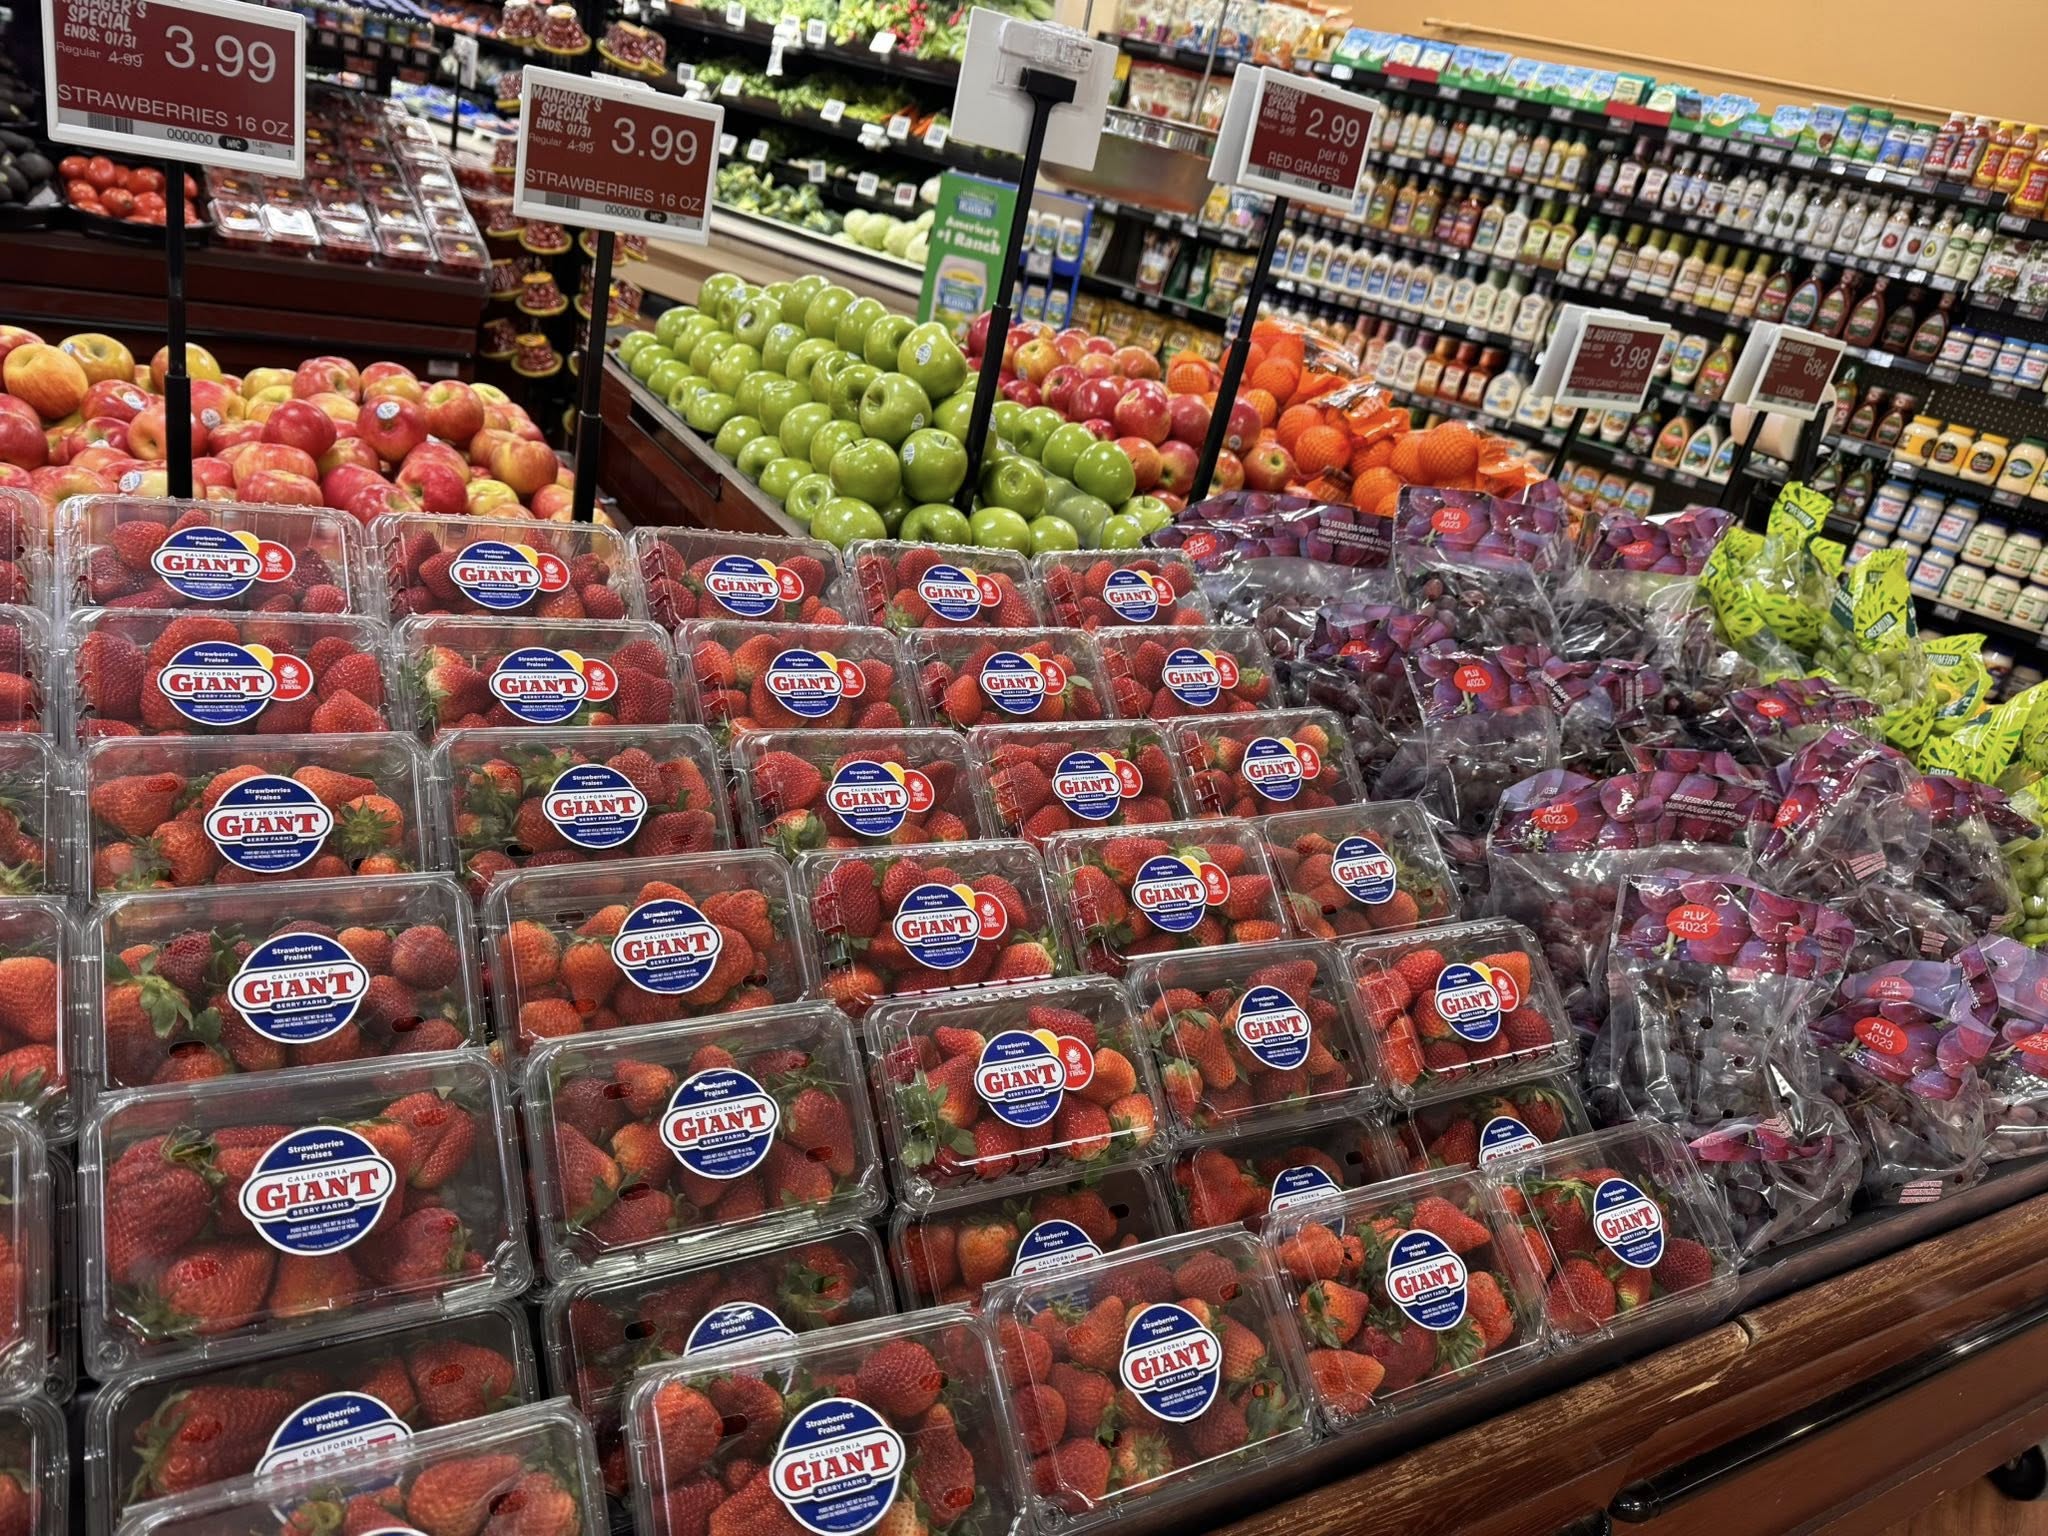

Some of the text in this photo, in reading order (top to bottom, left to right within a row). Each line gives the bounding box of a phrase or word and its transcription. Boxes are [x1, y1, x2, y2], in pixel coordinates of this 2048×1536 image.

[67, 4, 132, 33] SPECIAL
[64, 22, 137, 49] ENDS: 01/31
[56, 41, 145, 68] Regular 4.99
[164, 25, 277, 83] 3.99
[531, 84, 603, 112] MANAGER'S
[1267, 95, 1298, 114] SPECIAL
[57, 84, 294, 139] STRAWBERRIES 16 OZ.
[540, 102, 589, 125] SPECIAL
[167, 127, 213, 145] 000000
[536, 117, 592, 139] ENDS: 01/31
[1305, 108, 1361, 148] 2.99
[528, 133, 562, 147] Regular
[611, 117, 698, 166] 3.99
[1317, 148, 1349, 166] per lb
[1267, 151, 1341, 181] RED GRAPES
[525, 168, 654, 204] STRAWBERRIES
[659, 192, 676, 207] 16
[604, 204, 641, 219] 000000
[945, 215, 1000, 238] America's
[954, 231, 1001, 256] Ranch
[1610, 344, 1652, 370] 3.98
[1444, 512, 1460, 520] PLU
[1331, 520, 1358, 531] SEEDLESS
[1439, 521, 1460, 529] 4023
[163, 556, 250, 573] GIANT
[459, 568, 532, 583] GIANT
[713, 579, 773, 594] GIANT
[925, 587, 975, 599] GIANT
[1110, 590, 1152, 602] GIANT
[1169, 671, 1214, 684] GIANT
[1463, 669, 1479, 678] PLU
[170, 675, 264, 692] GIANT
[500, 678, 577, 693] GIANT
[774, 677, 835, 690] GIANT
[987, 676, 1038, 689] GIANT
[1466, 678, 1486, 687] 4023
[1060, 778, 1114, 794] GIANT
[836, 790, 901, 807] GIANT
[1670, 793, 1684, 801] RED
[554, 796, 635, 817] GIANT
[218, 813, 319, 836] GIANT
[1541, 815, 1568, 824] 4023
[1339, 860, 1389, 880] GIANT
[1141, 884, 1199, 904] GIANT
[1683, 911, 1706, 920] PLU
[903, 915, 971, 938] GIANT
[1678, 921, 1708, 934] 4023
[272, 945, 323, 954] Strawberries
[623, 932, 710, 961] GIANT
[272, 970, 326, 979] CALIFORNIA
[244, 972, 354, 1004] GIANT
[1443, 990, 1494, 1014] GIANT
[1245, 1015, 1303, 1039] GIANT
[1871, 1022, 1894, 1037] PLU
[1865, 1032, 1894, 1050] 4023
[985, 1064, 1056, 1093] GIANT
[704, 1089, 728, 1097] Fraises
[696, 1104, 742, 1116] CALIFORNIA
[673, 1104, 766, 1141] GIANT
[288, 1140, 344, 1153] Strawberries
[703, 1133, 745, 1145] BERRY FARMS
[301, 1150, 332, 1160] Fraises
[288, 1168, 348, 1182] CALIFORNIA
[257, 1168, 379, 1212] GIANT
[293, 1202, 349, 1216] BERRY FARMS
[1603, 1206, 1655, 1238] GIANT
[1035, 1230, 1069, 1243] Strawberries
[1044, 1239, 1063, 1249] Fraises
[1038, 1253, 1075, 1267] CALIFORNIA
[1396, 1262, 1459, 1298] GIANT
[1141, 1315, 1179, 1330] Strawberries
[1152, 1325, 1173, 1335] Fraises
[1148, 1341, 1187, 1356] CALIFORNIA
[1132, 1339, 1210, 1383] GIANT
[302, 1404, 361, 1426] Strawberries
[805, 1412, 854, 1429] Strawberries
[316, 1418, 349, 1433] Fraises
[818, 1423, 845, 1435] Fraises
[303, 1436, 365, 1458] CALIFORNIA
[809, 1442, 861, 1459] CALIFORNIA
[785, 1441, 889, 1491] GIANT
[818, 1477, 867, 1495] BERRY FARMS
